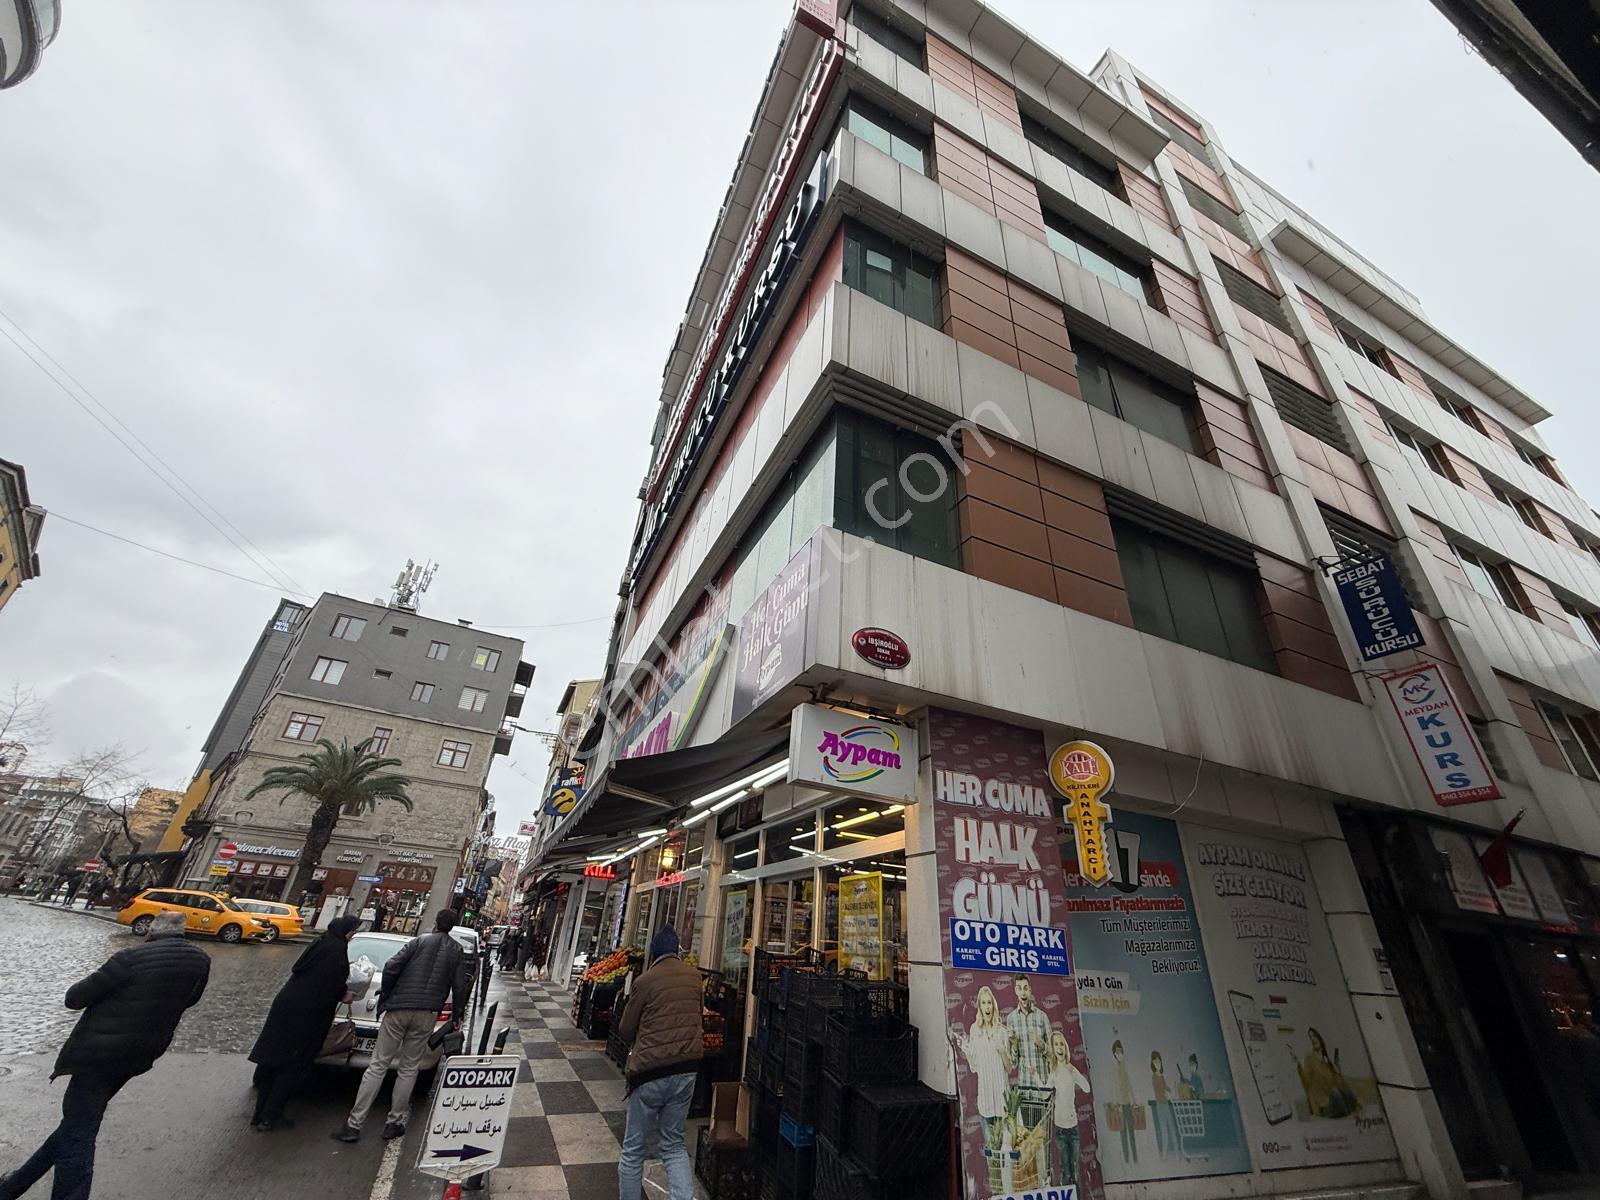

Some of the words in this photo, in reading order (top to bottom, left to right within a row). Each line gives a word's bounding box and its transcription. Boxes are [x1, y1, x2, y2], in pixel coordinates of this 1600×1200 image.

[721, 182, 807, 376] KURSU
[1337, 558, 1385, 586] SEBAT
[772, 563, 806, 612] Cuma
[741, 623, 773, 673] Halk
[773, 581, 810, 643] Günü
[868, 635, 899, 651] İBŞİROĞLU
[1364, 632, 1420, 657] KURSU
[1404, 700, 1450, 716] MEYDAN
[817, 730, 902, 770] Aypam
[1416, 712, 1472, 789] KURS
[1061, 757, 1100, 777] KALE
[935, 769, 983, 807] HER
[985, 777, 1052, 818] CUMA
[1079, 792, 1099, 874] ANAHTARCI
[953, 816, 1041, 872] HALK
[1139, 871, 1172, 888] sinde
[952, 871, 1051, 927] GÜNÜ
[1113, 896, 1187, 914] Fiyatlarımızla
[954, 920, 1001, 944] OTO
[1006, 925, 1065, 950] PARK
[1100, 918, 1122, 932] Tüm
[1123, 917, 1191, 936] Müşterilerimizi
[956, 947, 982, 955] KARAYEL
[1041, 954, 1066, 962] KARAYEL
[1125, 938, 1196, 957] Mağazalarımıza
[1152, 957, 1202, 975] Bekliyoruz!
[1097, 977, 1102, 988] 1
[1104, 977, 1124, 990] Gün
[1084, 994, 1110, 1009] Sizin
[1112, 995, 1131, 1013] İçin
[446, 1070, 514, 1086] OTOPARK
[442, 1095, 477, 1111] سيارات
[479, 1093, 506, 1110] غسيل
[433, 1121, 473, 1138] السيارات
[475, 1119, 502, 1137] موقف
